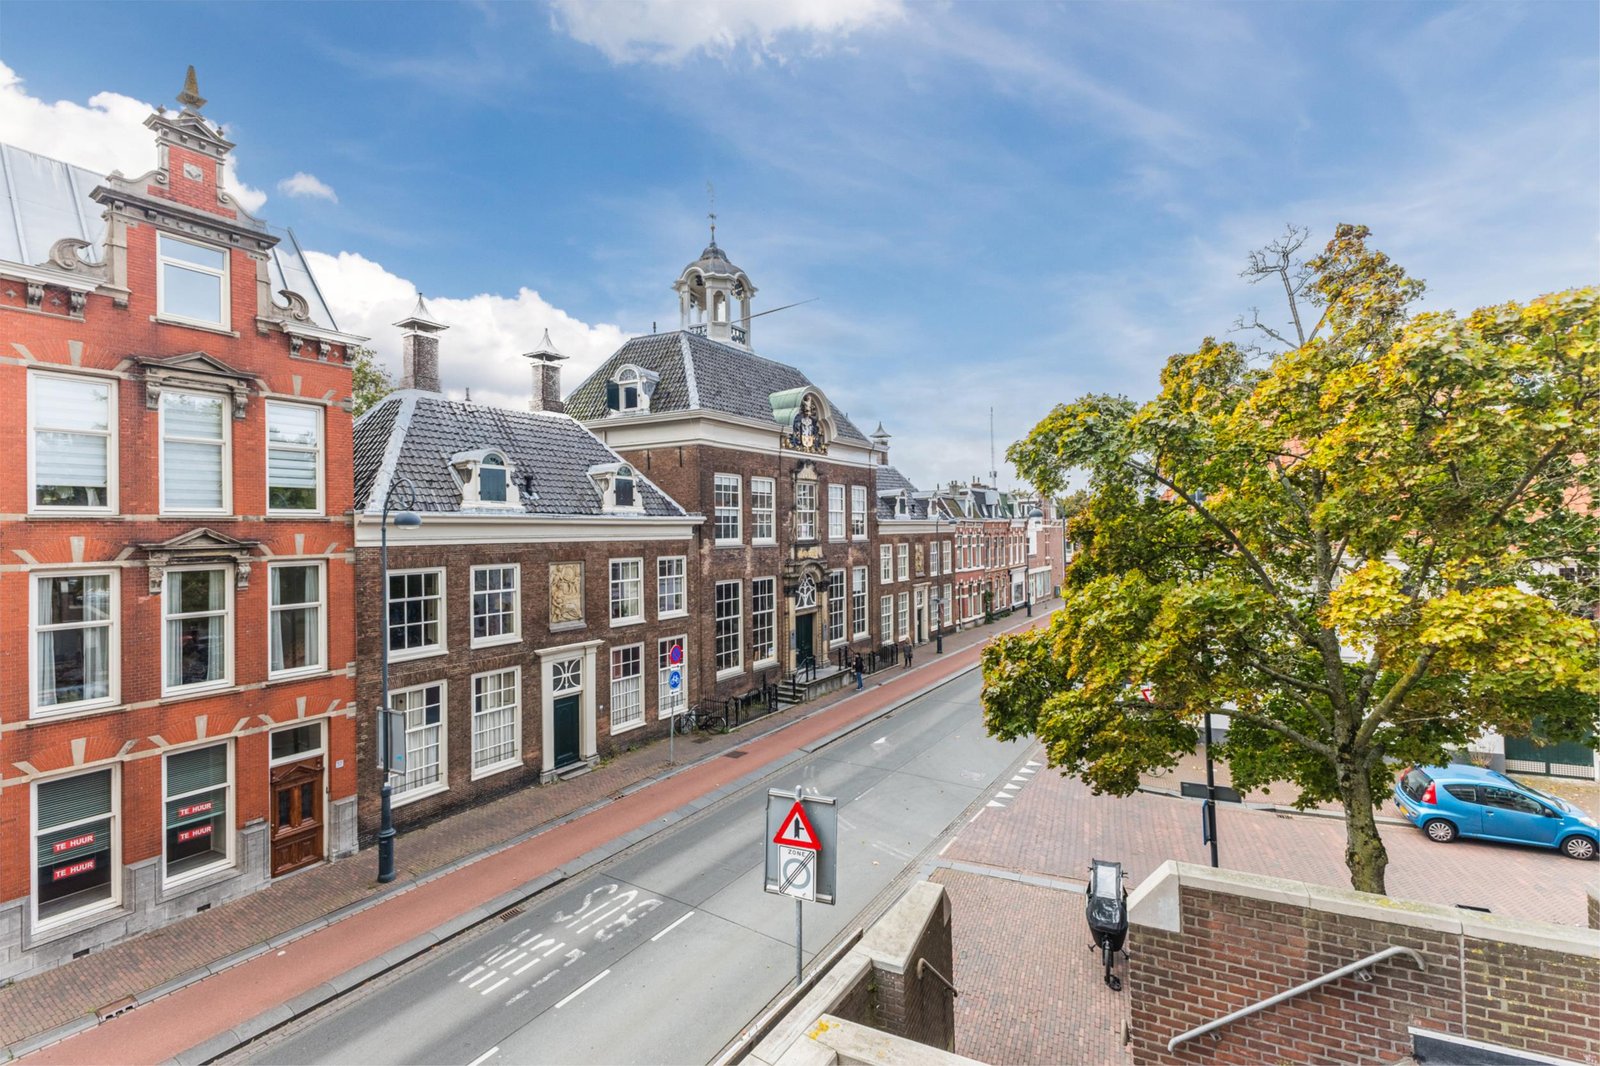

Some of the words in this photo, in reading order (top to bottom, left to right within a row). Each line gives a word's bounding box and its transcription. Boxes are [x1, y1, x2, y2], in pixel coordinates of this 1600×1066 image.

[180, 808, 190, 816] TE
[192, 802, 212, 813] HUUR
[180, 832, 190, 840] TE
[192, 826, 212, 837] HUUR
[55, 842, 67, 851] TE
[70, 835, 94, 847] HUUR
[787, 849, 806, 858] ZONE
[55, 868, 67, 878] TE
[70, 861, 94, 874] HUUR
[552, 883, 664, 943] BUS
